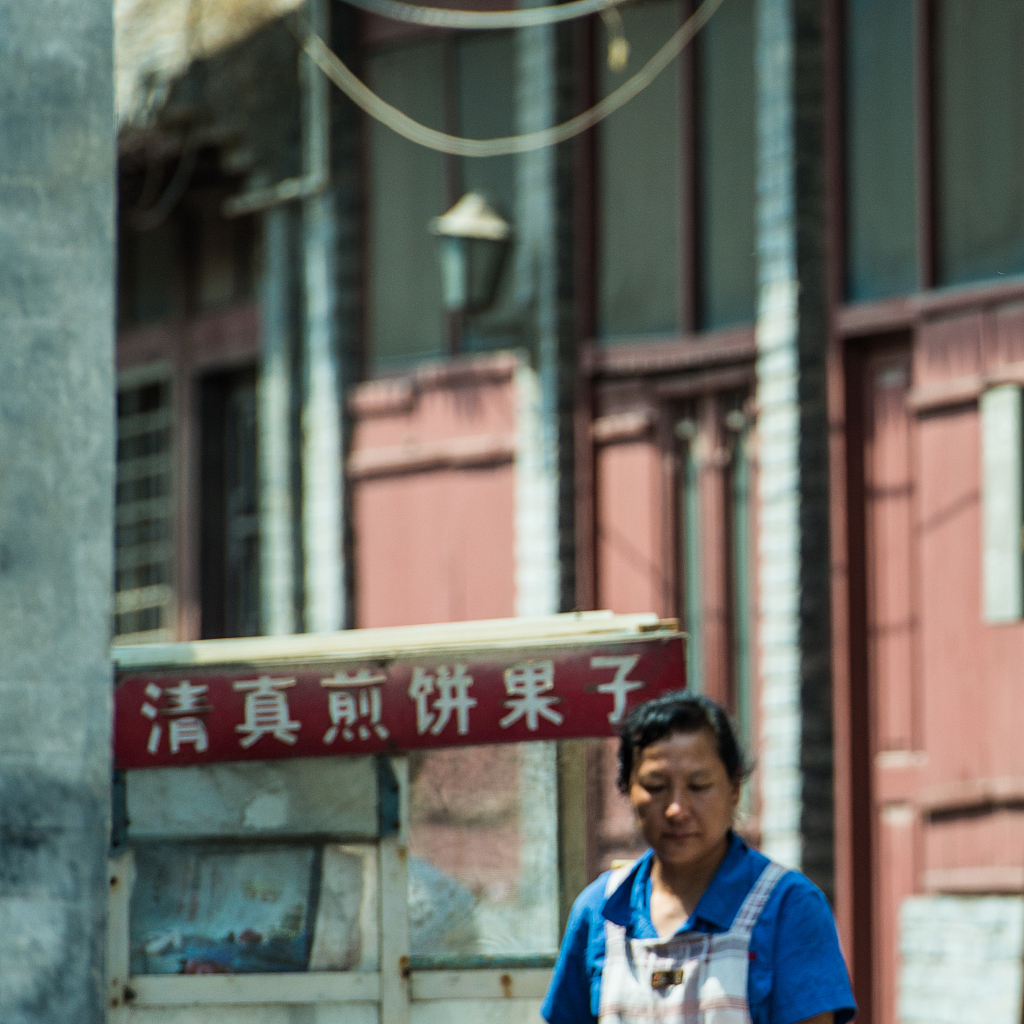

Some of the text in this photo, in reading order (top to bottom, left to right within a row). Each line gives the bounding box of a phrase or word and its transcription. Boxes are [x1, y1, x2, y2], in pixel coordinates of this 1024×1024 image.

[140, 655, 647, 755] 清真煎饼果子
